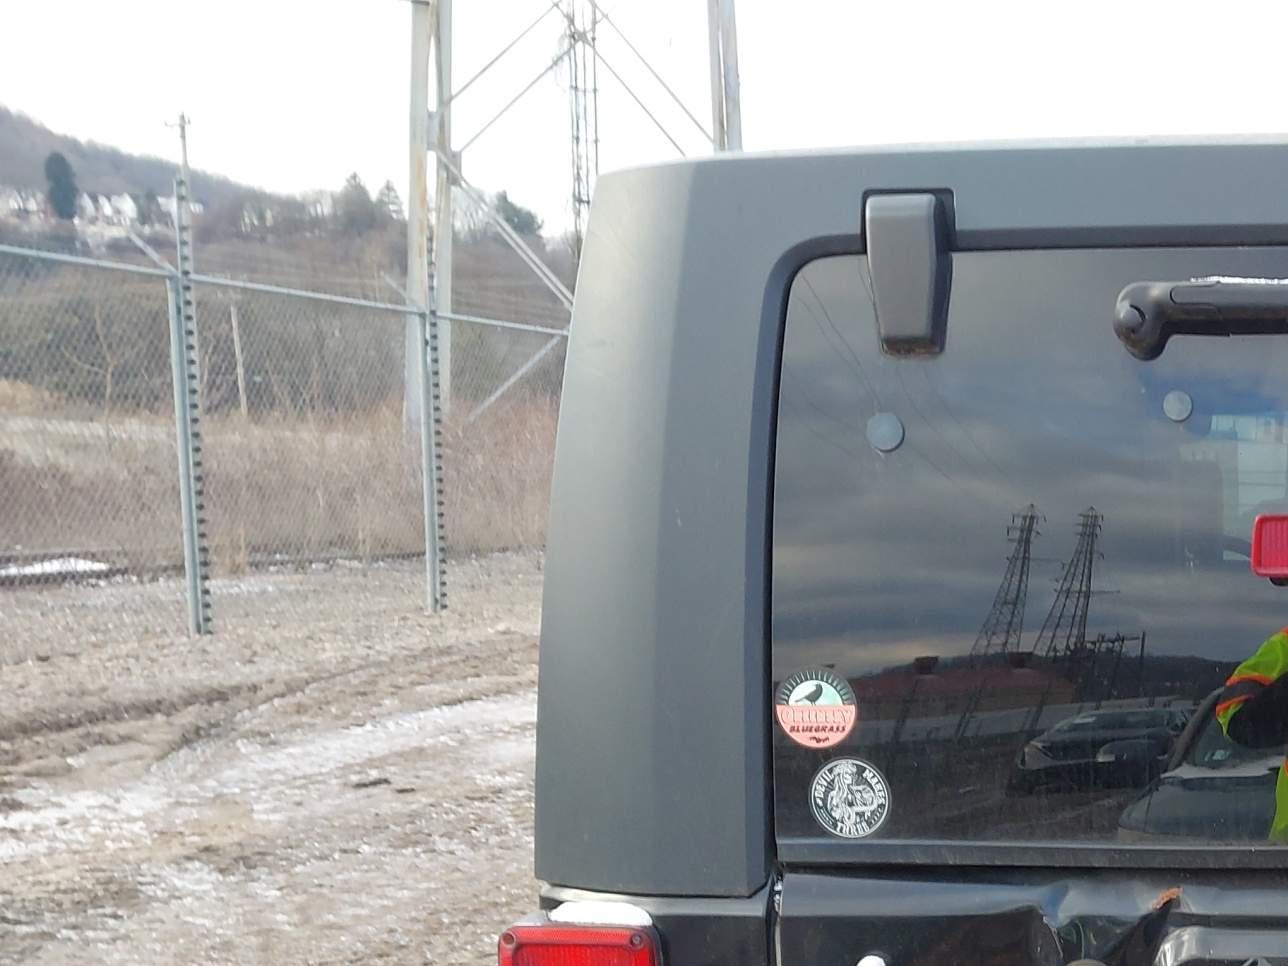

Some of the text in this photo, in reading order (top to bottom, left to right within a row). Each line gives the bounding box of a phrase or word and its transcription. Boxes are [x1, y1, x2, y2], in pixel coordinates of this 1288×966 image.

[789, 725, 847, 733] BLUEGRASS
[814, 769, 834, 799] DEVIL
[836, 821, 870, 836] THREE
